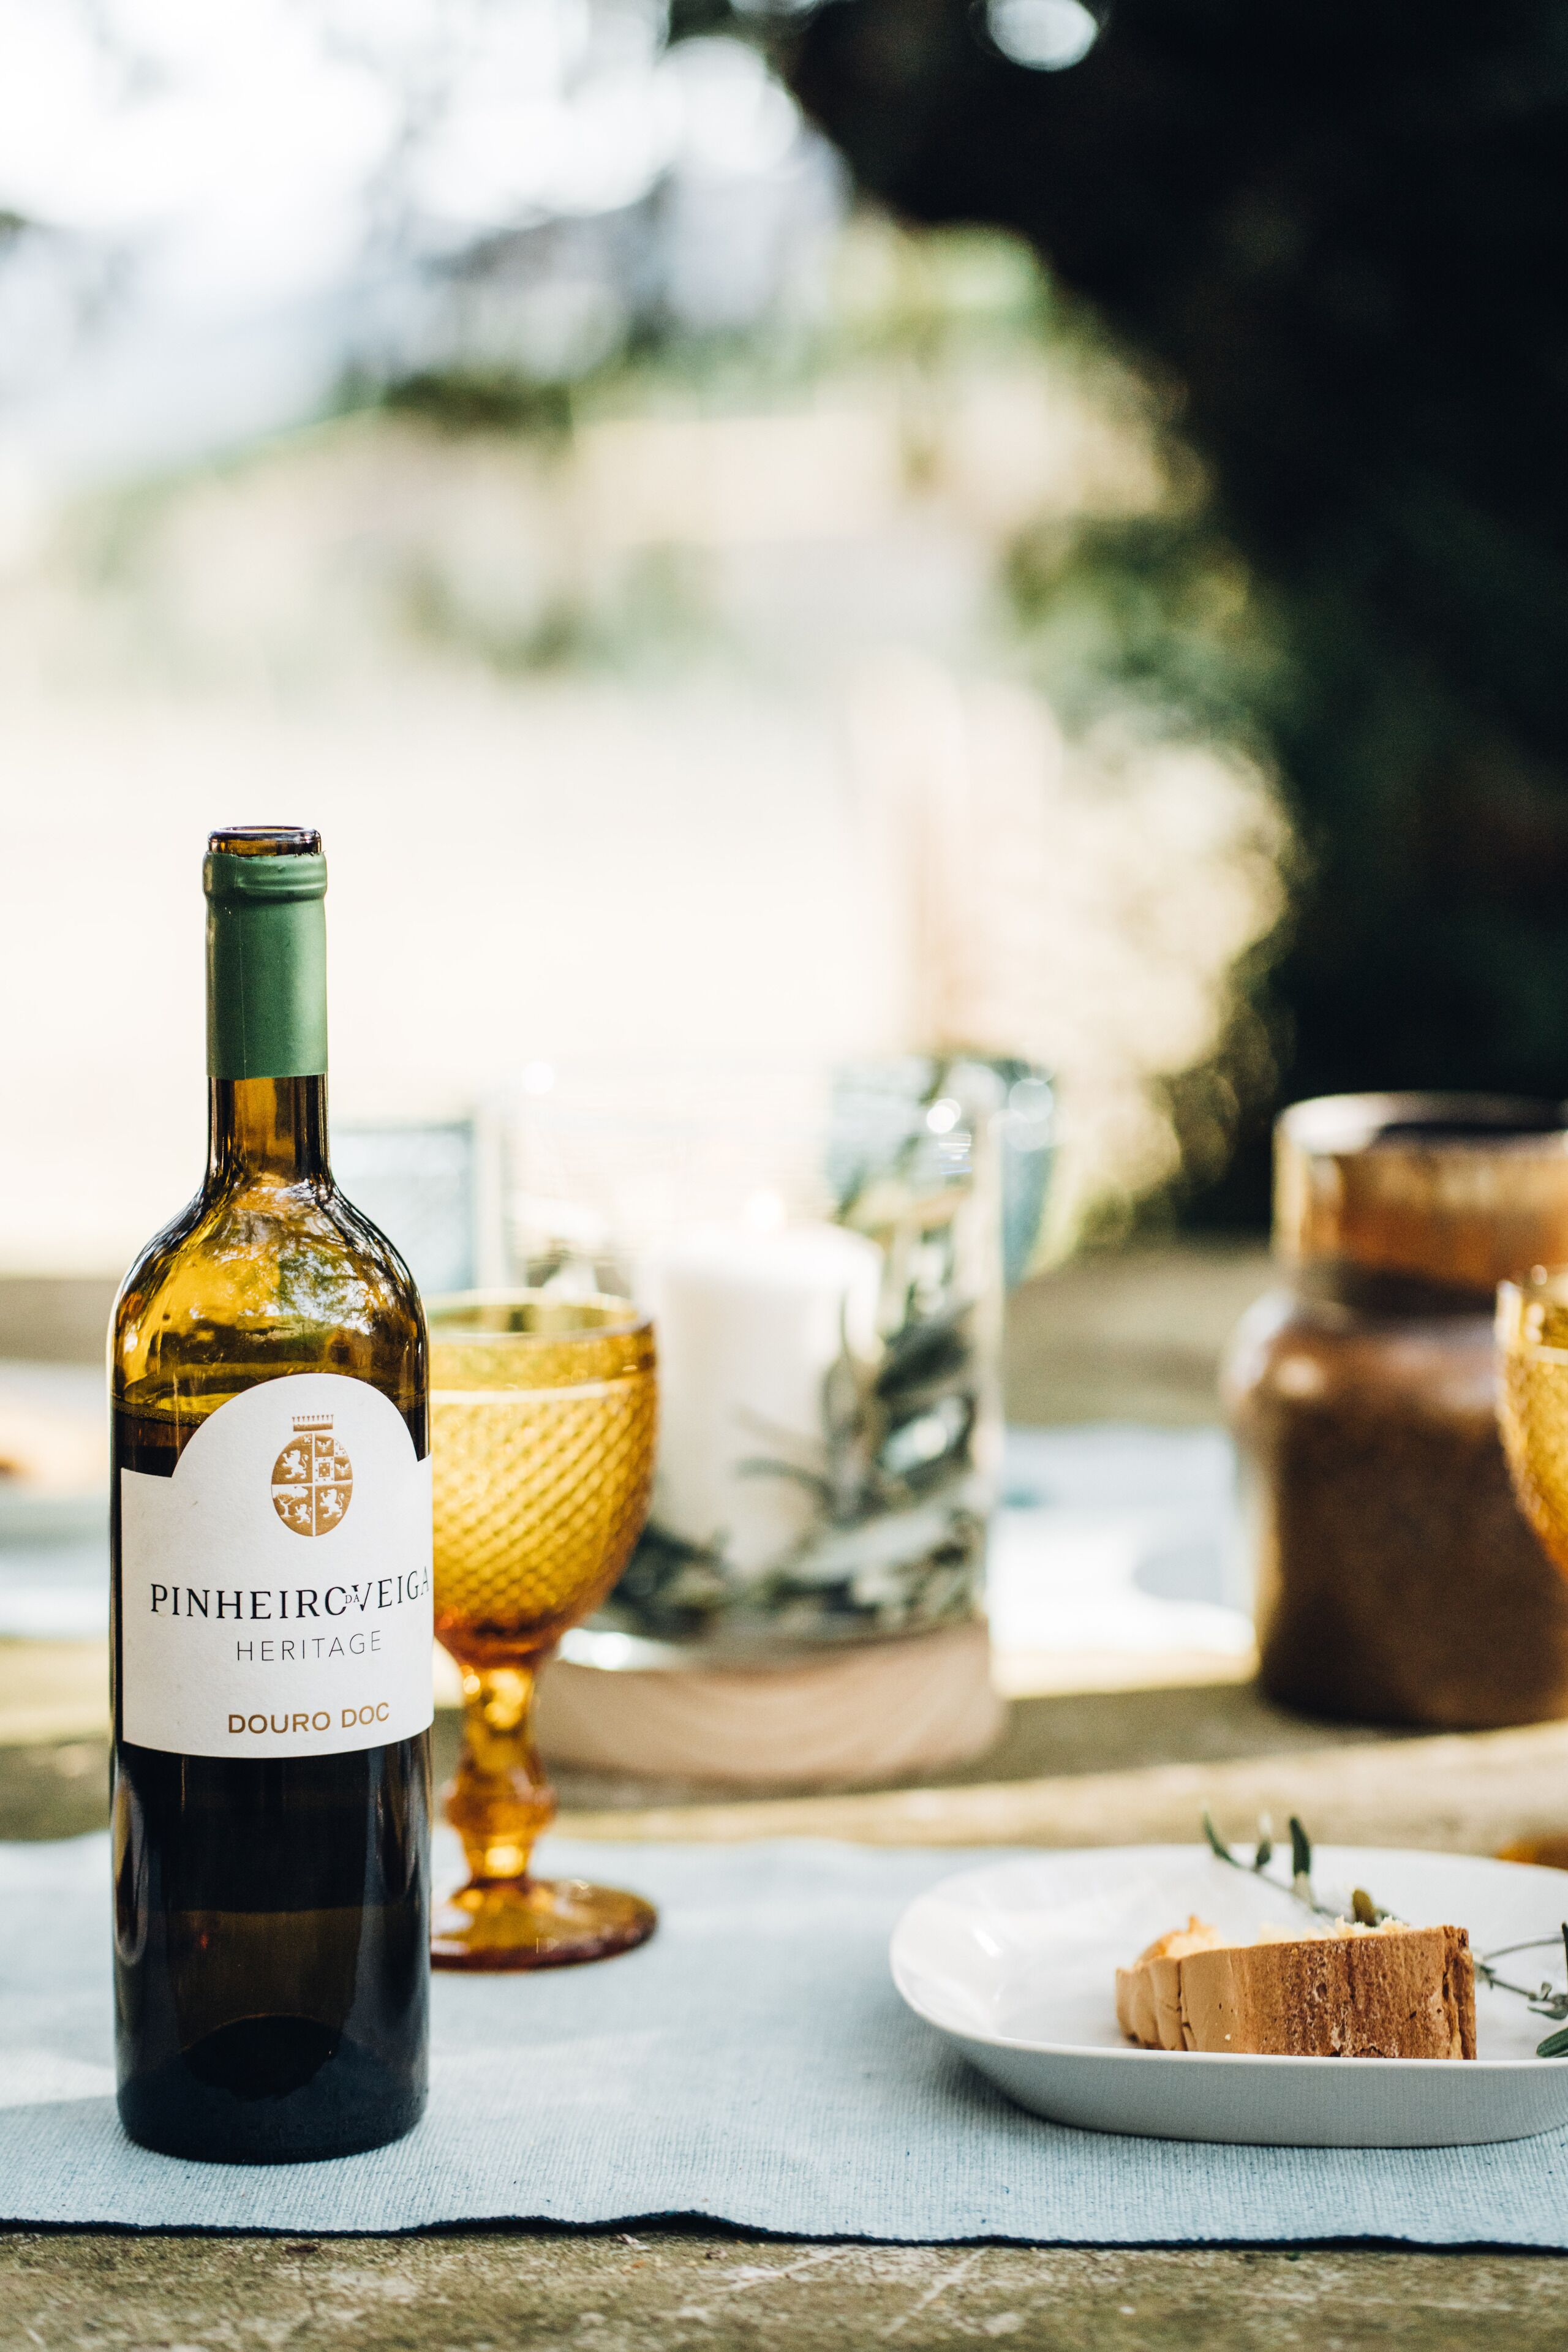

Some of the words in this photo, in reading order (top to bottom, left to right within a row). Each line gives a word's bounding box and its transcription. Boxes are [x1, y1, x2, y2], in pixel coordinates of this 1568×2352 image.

[151, 1583, 347, 1619] PINHEIRO
[345, 1594, 360, 1604] DA
[351, 1566, 429, 1611] VEIGA
[236, 1630, 382, 1662] HERITAGE
[228, 1711, 331, 1734] DOURO
[341, 1702, 390, 1728] DOC
